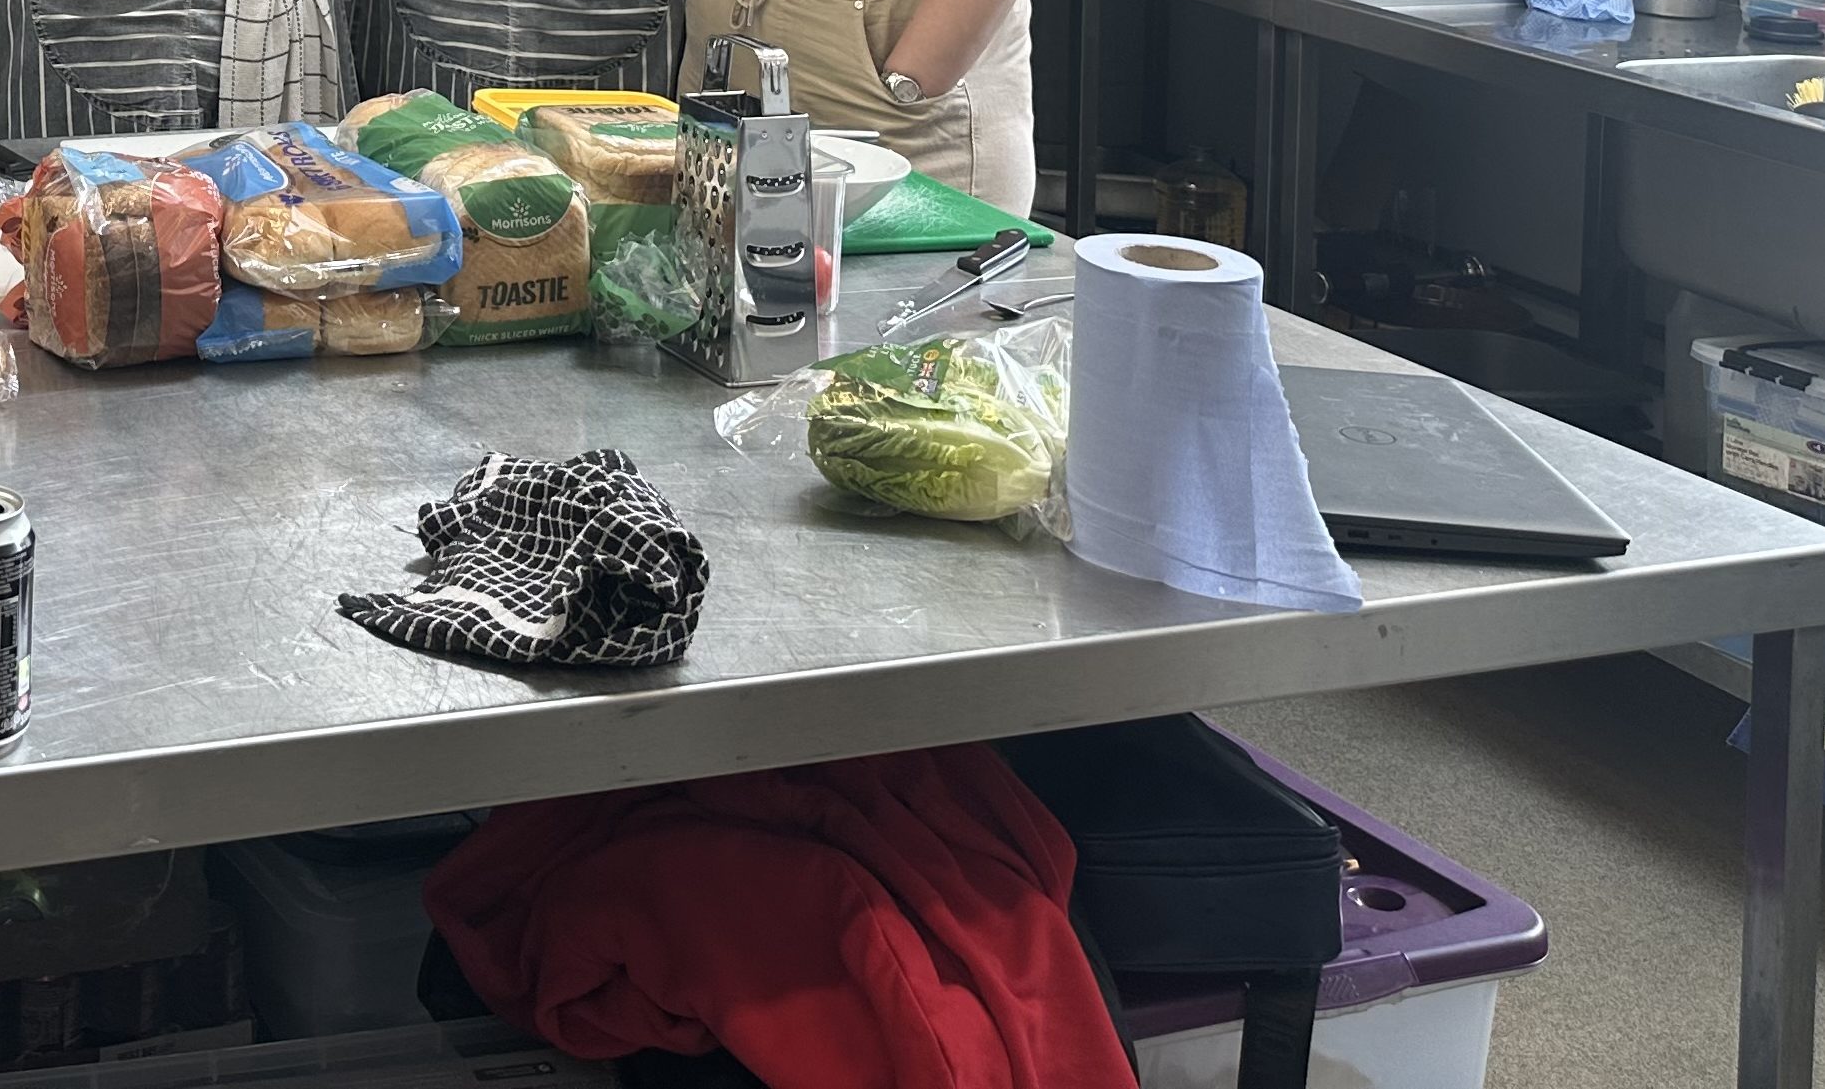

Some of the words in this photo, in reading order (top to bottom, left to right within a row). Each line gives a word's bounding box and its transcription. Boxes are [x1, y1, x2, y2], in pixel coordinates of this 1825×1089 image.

[491, 215, 552, 230] Morrisons
[477, 275, 569, 309] TOASTIE
[469, 332, 497, 343] THICK
[500, 328, 536, 340] SLICED
[538, 325, 570, 335] WHITE
